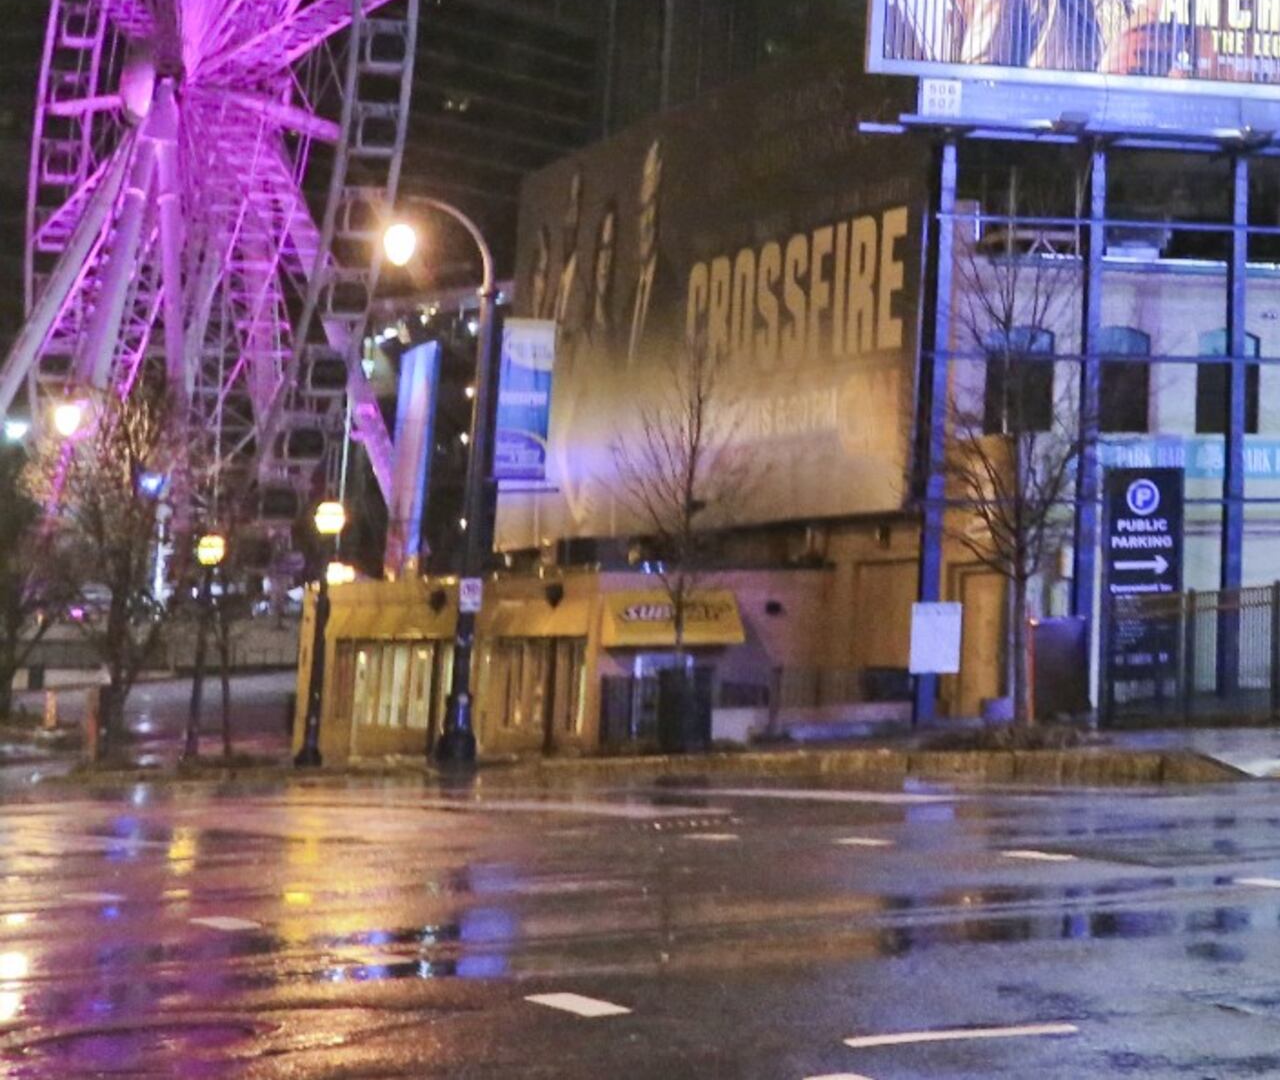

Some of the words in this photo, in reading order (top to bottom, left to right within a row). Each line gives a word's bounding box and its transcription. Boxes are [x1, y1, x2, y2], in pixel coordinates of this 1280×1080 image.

[1212, 29, 1245, 56] THE
[684, 206, 908, 368] CROSSFIRE
[1243, 447, 1272, 473] ARK
[1117, 518, 1168, 533] PUBLIC
[1111, 535, 1173, 549] PARKING
